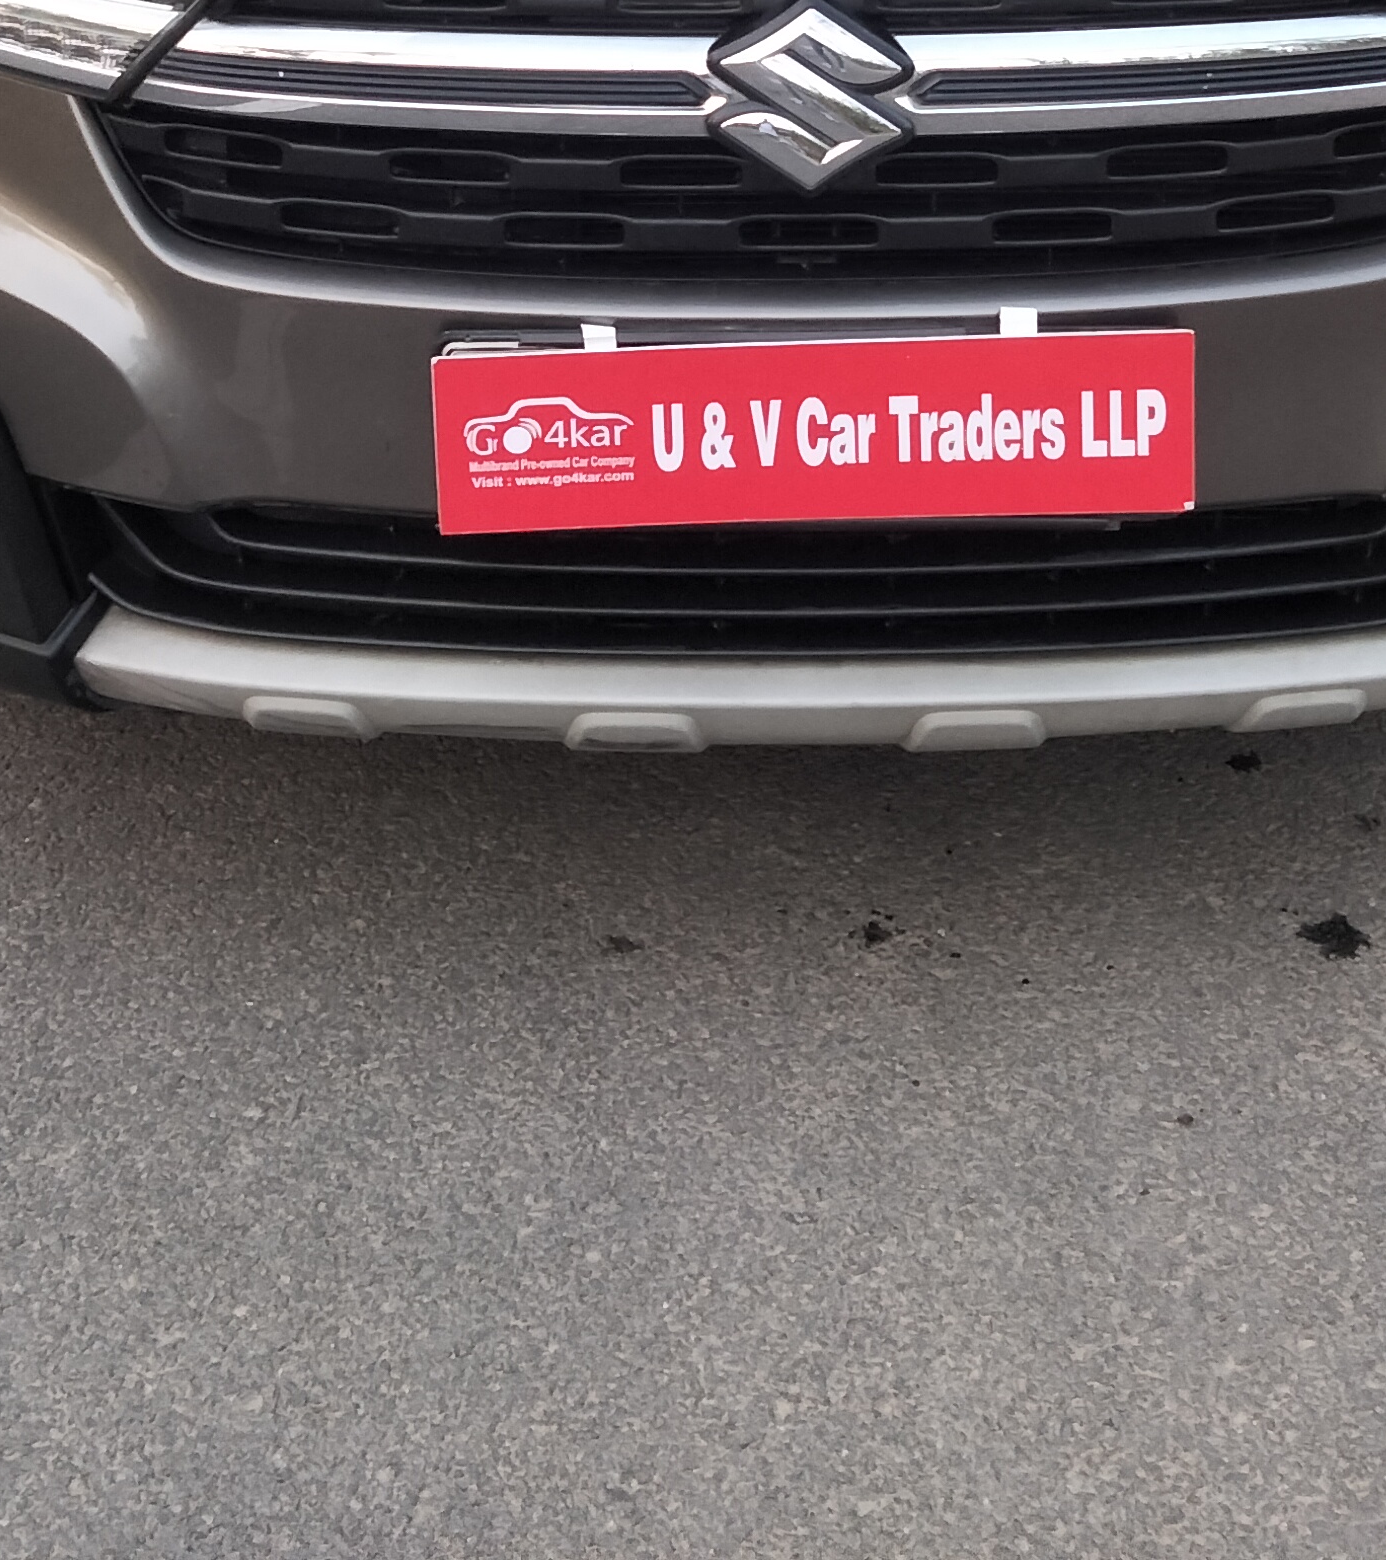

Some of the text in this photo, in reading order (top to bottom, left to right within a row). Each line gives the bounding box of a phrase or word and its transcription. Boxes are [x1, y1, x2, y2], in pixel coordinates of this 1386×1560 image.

[651, 388, 1167, 472] U & V Car Traders LLP
[572, 456, 589, 468] Car
[590, 455, 635, 469] Company
[471, 476, 504, 488] Visit
[514, 471, 635, 487] www.go4kar.com
